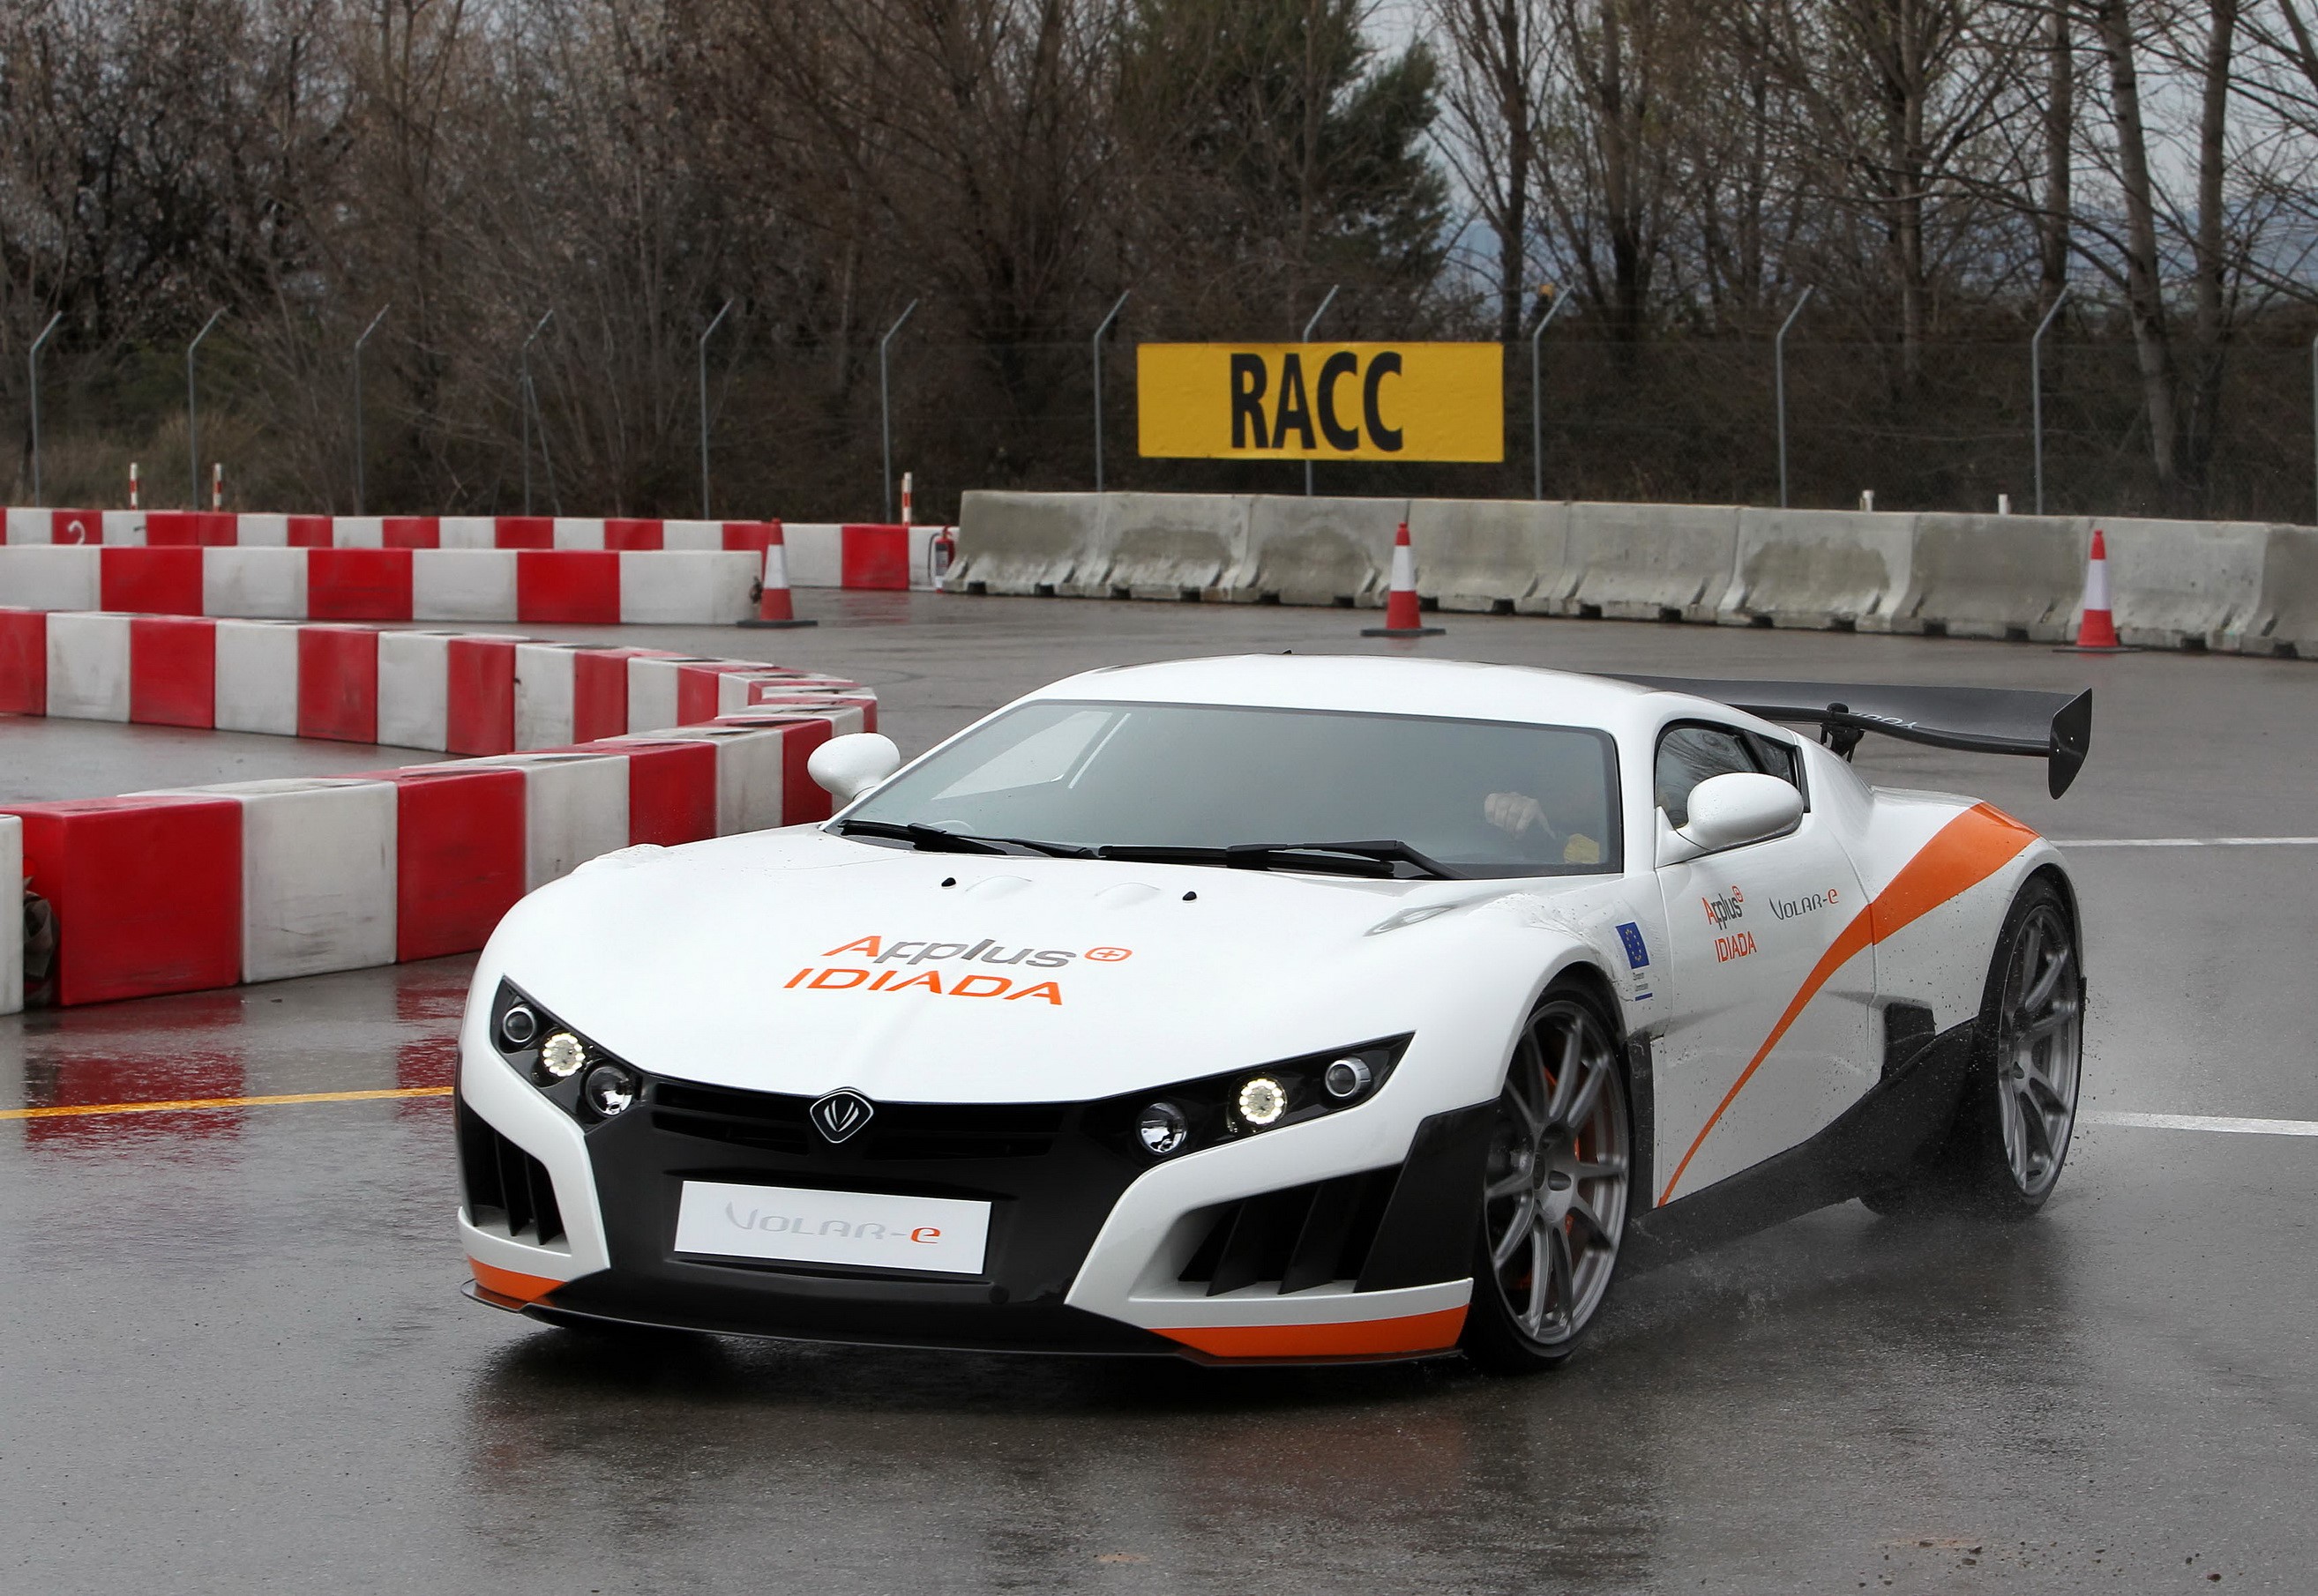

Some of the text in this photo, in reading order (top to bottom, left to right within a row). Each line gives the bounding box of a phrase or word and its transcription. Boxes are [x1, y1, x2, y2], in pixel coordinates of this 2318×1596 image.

[1230, 350, 1404, 452] RACC
[1714, 930, 1758, 963] IDIADA
[782, 967, 1063, 1006] IDIADA
